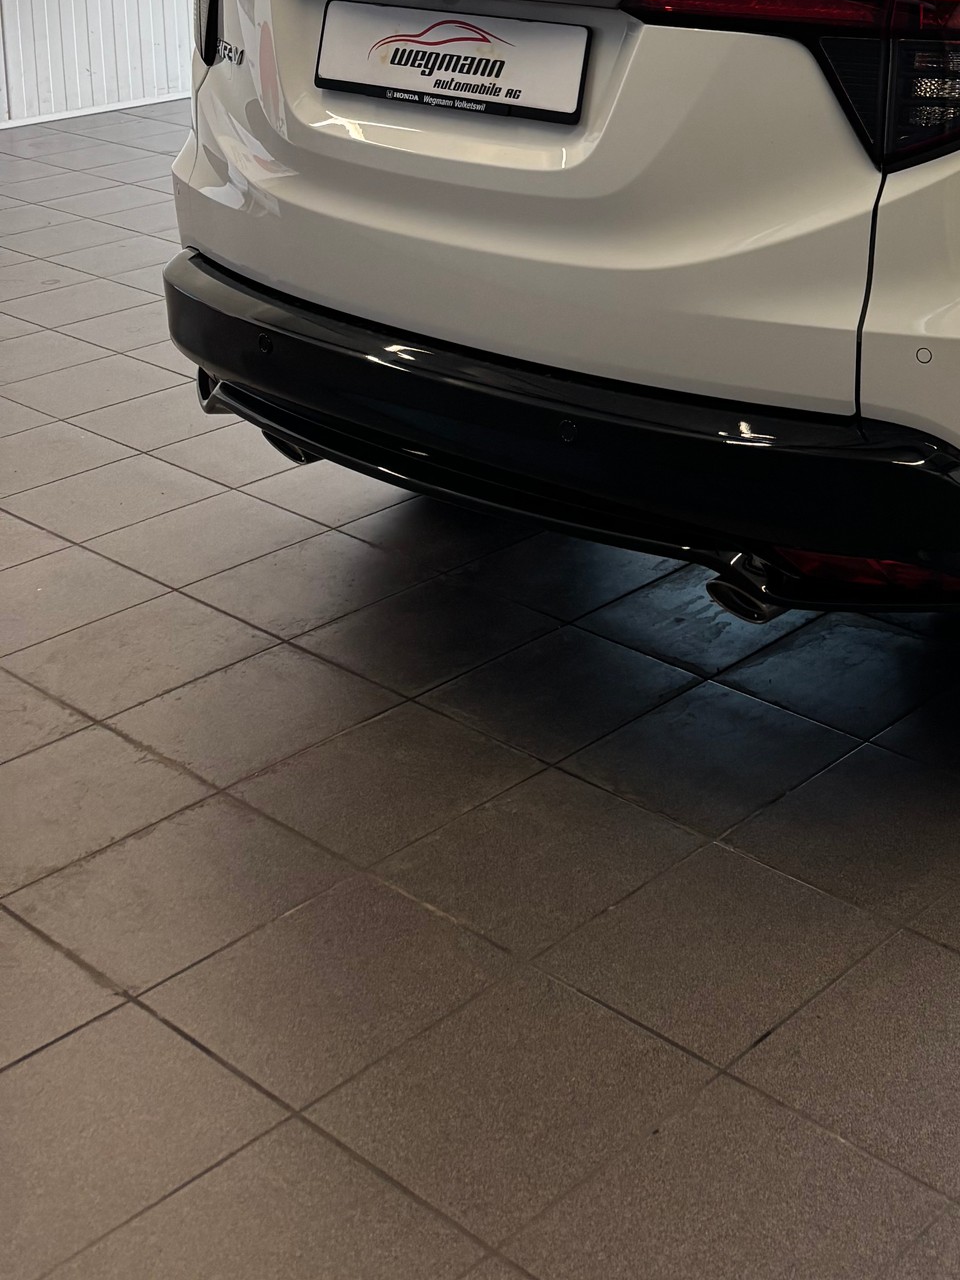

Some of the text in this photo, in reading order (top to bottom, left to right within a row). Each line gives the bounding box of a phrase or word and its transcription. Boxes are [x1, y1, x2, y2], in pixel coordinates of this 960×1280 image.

[390, 47, 506, 79] wegmann
[393, 91, 419, 102] HONDA
[423, 95, 454, 107] Wegmann
[454, 99, 486, 112] Volketswil
[504, 88, 522, 100] AG
